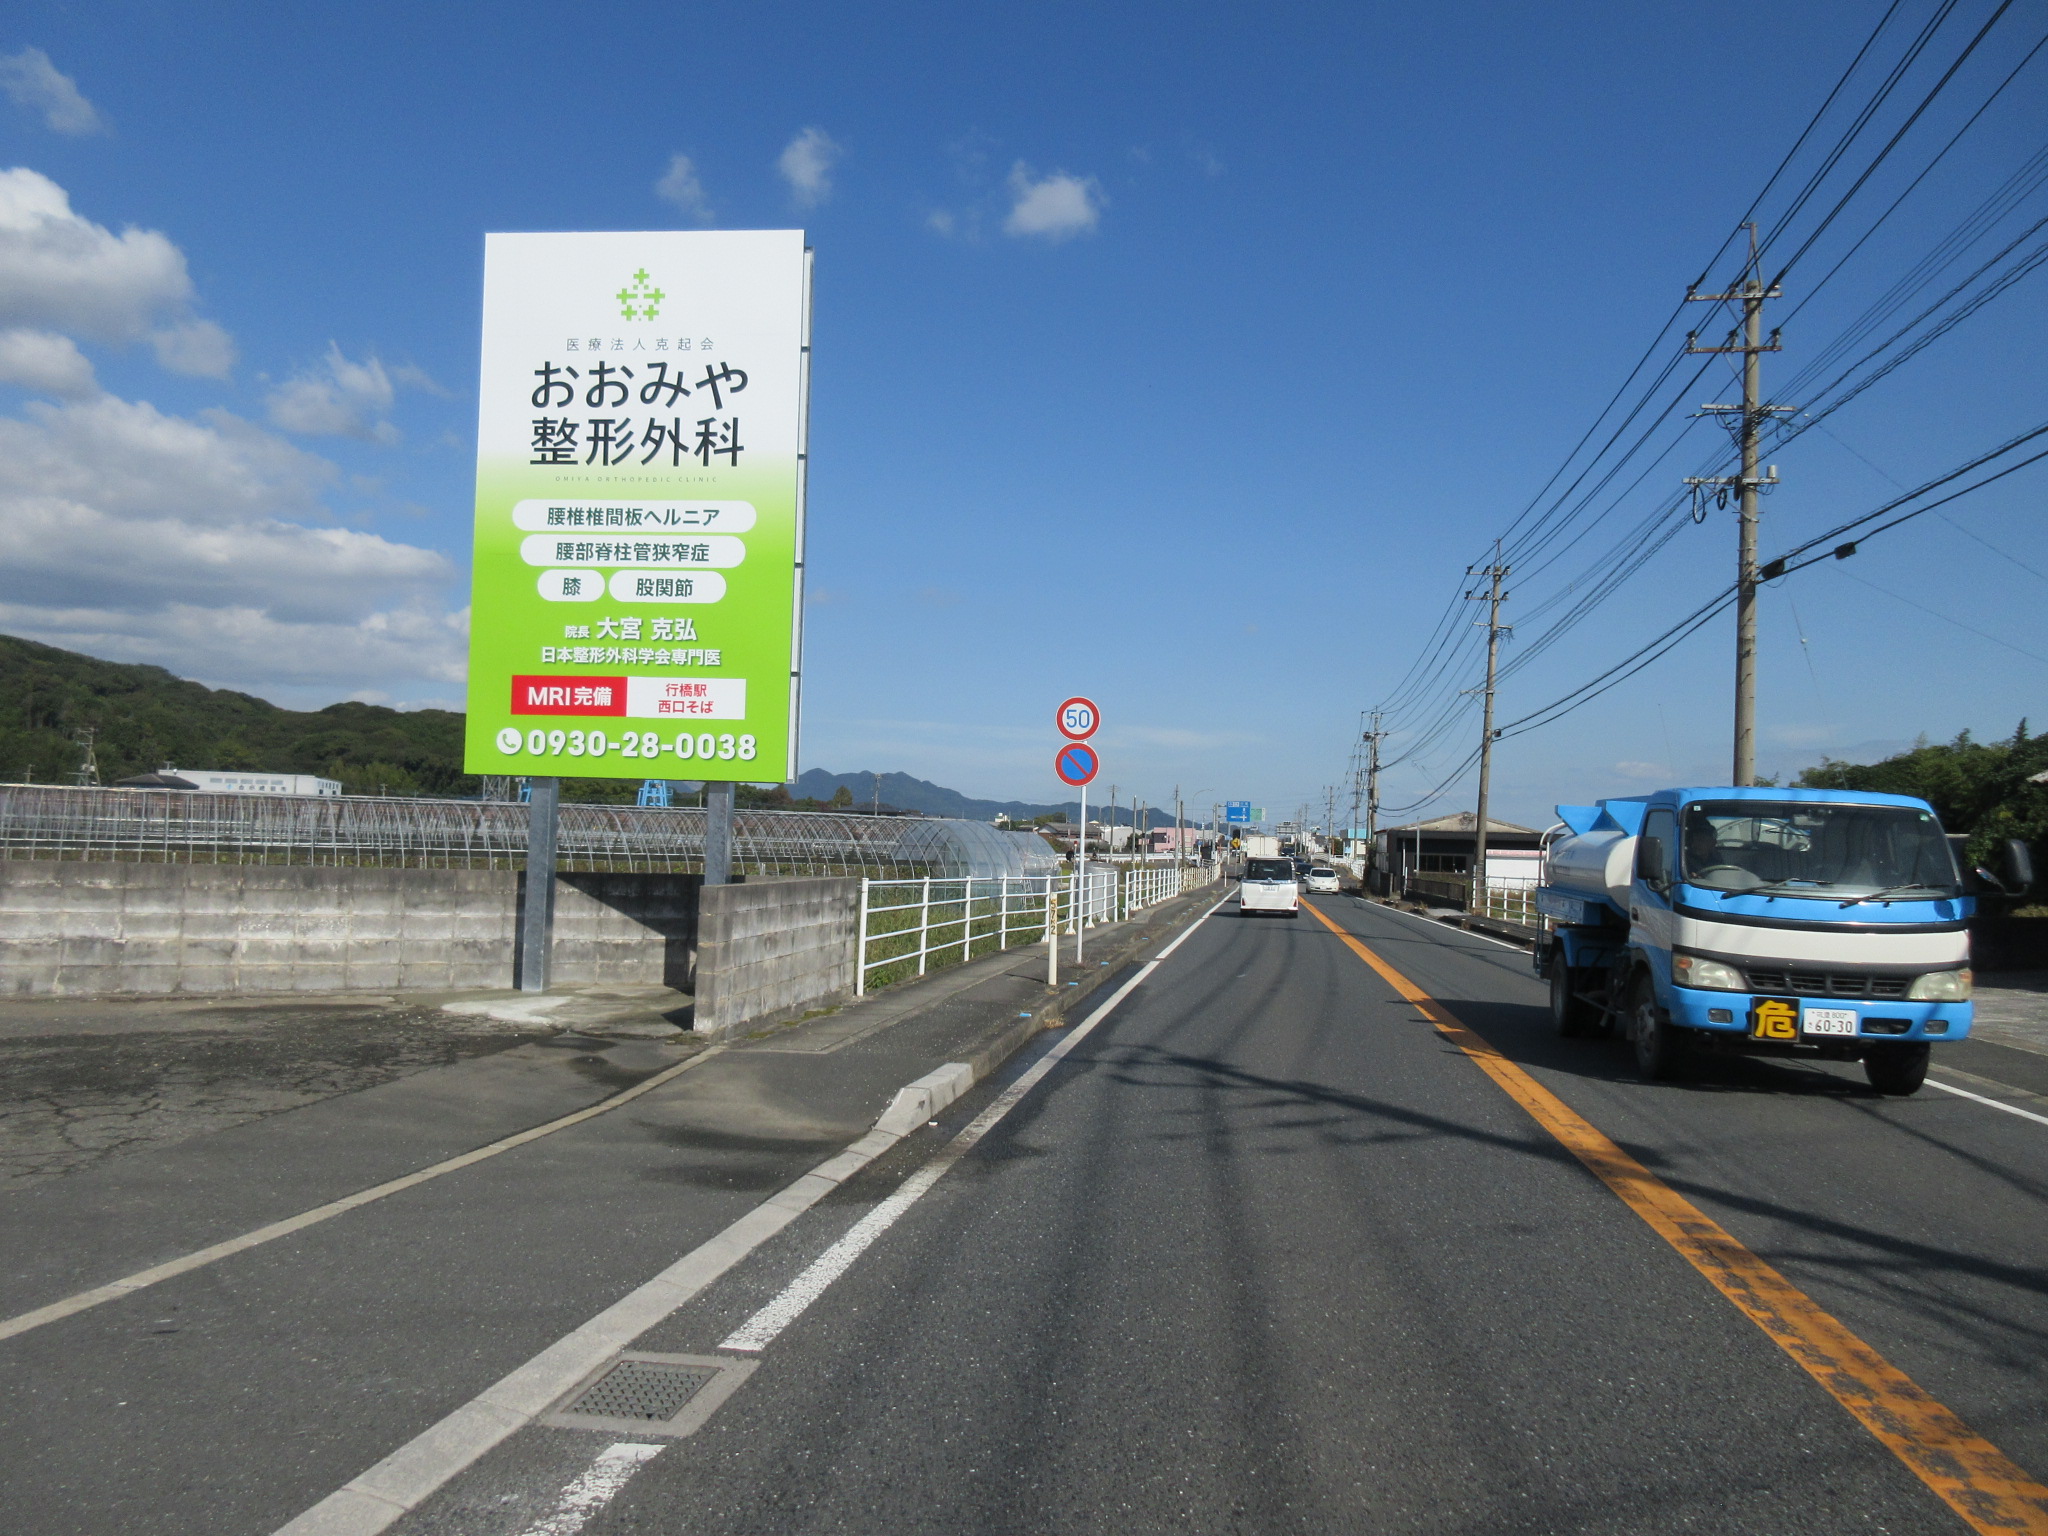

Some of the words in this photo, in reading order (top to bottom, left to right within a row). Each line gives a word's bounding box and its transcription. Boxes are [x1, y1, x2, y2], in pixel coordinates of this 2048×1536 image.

[566, 337, 714, 351] 医療法人克起会
[531, 360, 749, 410] おおみや
[529, 416, 745, 467] 整形外科
[547, 507, 720, 526] 腰椎椎間板ヘルニア
[555, 542, 710, 562] 腰部脊柱管狭窄症
[562, 577, 582, 596] 膝
[635, 578, 694, 597] 股関節
[564, 625, 590, 639] 院長
[596, 616, 642, 640] 大宮
[650, 617, 698, 641] 克弘
[541, 646, 721, 666] 日本整形外科学会専門医
[665, 683, 707, 698] 行橋駅
[658, 700, 714, 714] 西口そば
[1066, 709, 1090, 729] 50
[527, 729, 757, 761] 0930-28-0038
[1754, 1000, 1797, 1039] 危
[1815, 1019, 1853, 1033] 60-30
